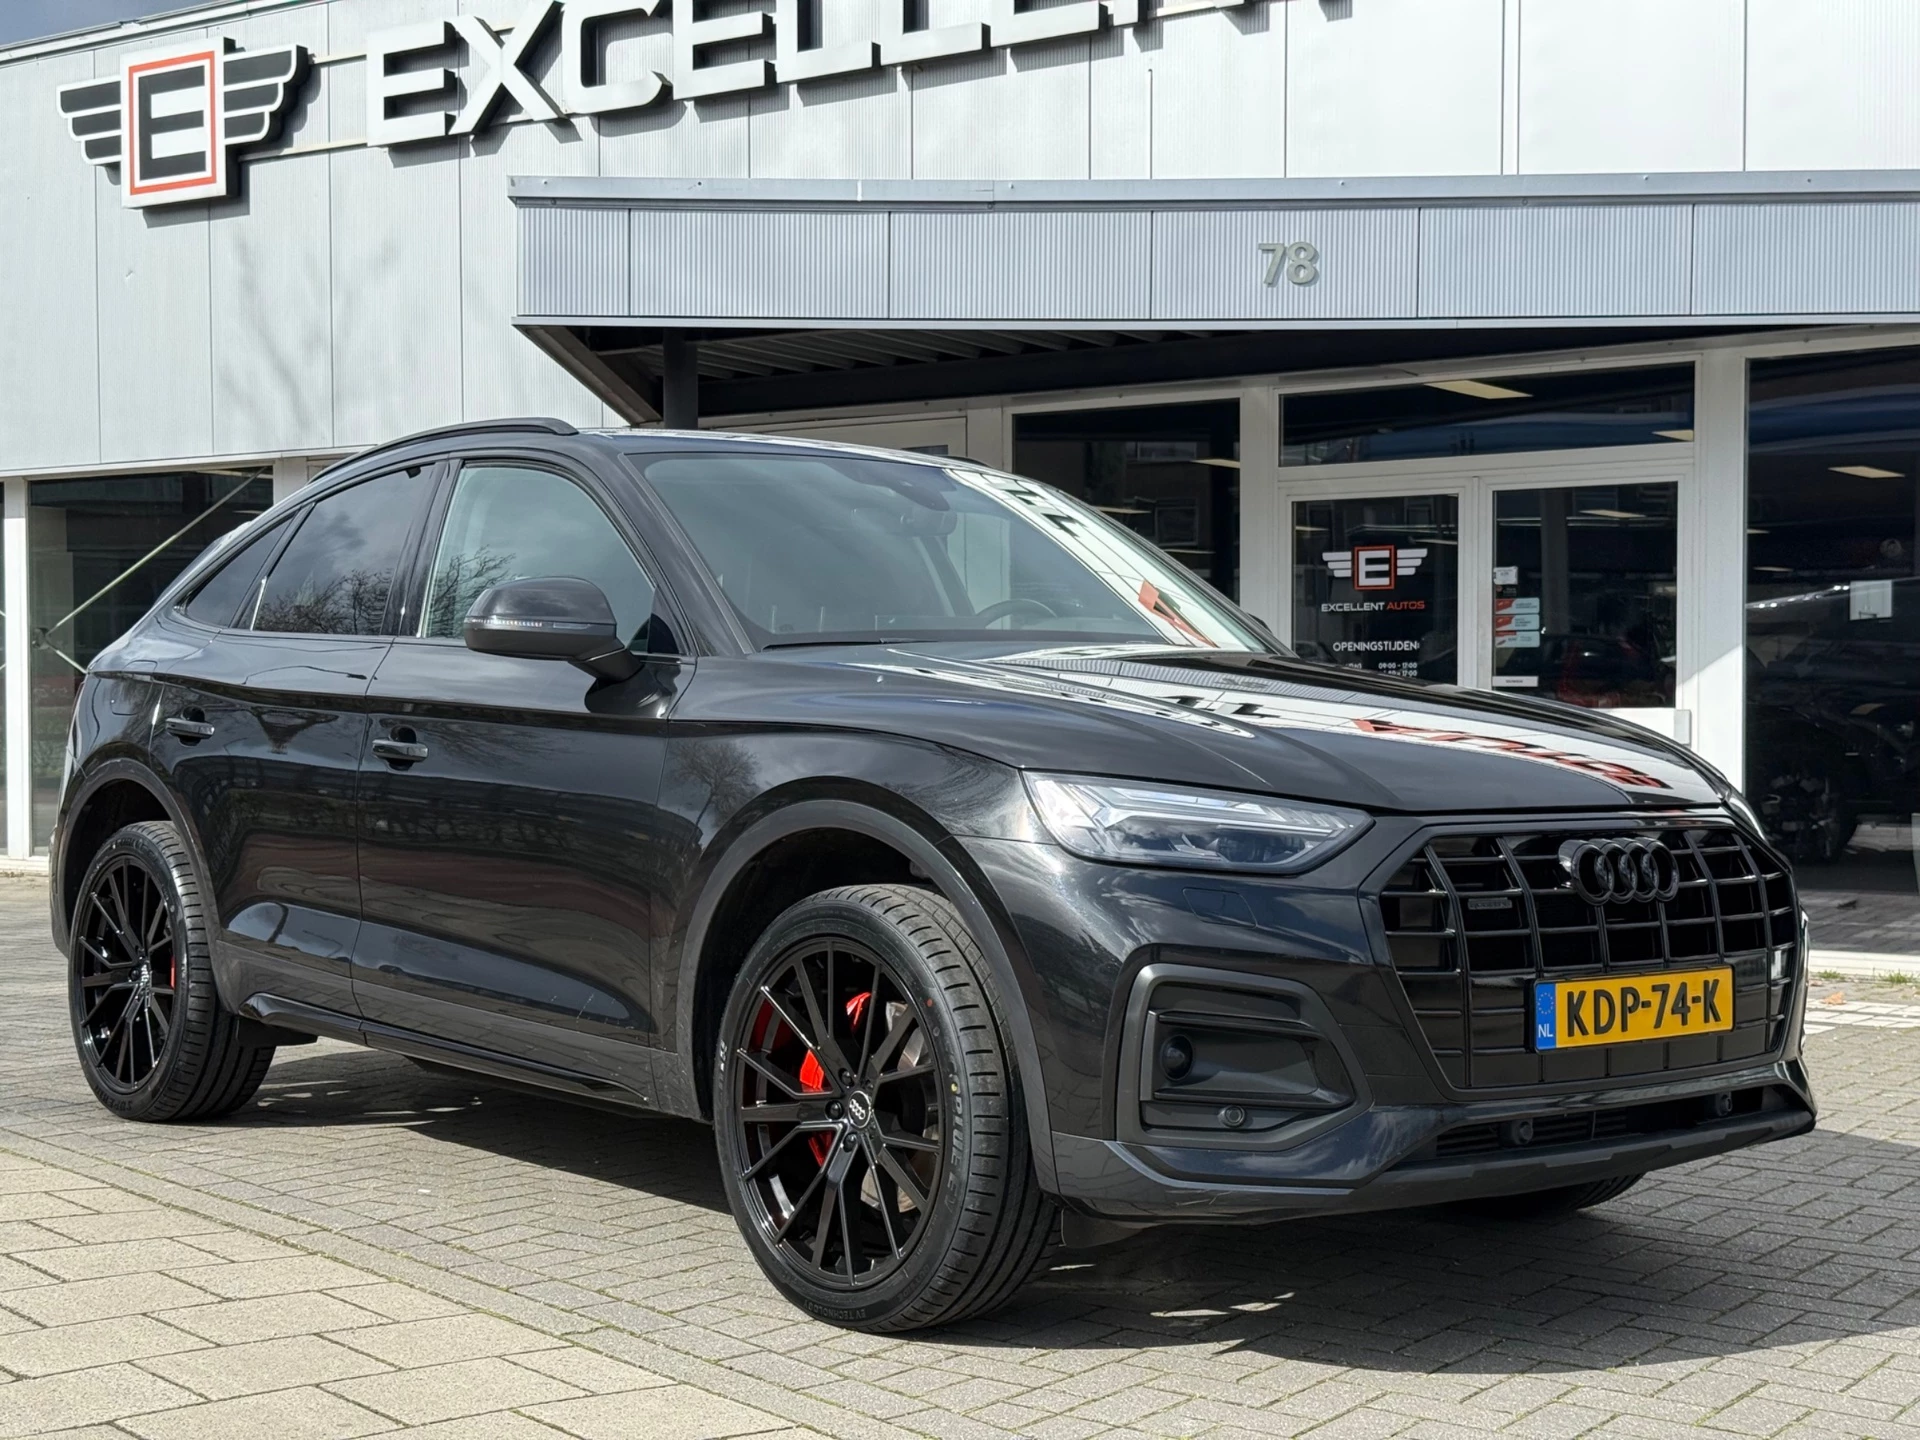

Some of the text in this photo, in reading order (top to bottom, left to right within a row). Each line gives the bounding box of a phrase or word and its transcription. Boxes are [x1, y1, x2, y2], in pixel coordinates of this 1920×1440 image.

[138, 64, 207, 181] E
[1258, 241, 1316, 285] 78
[1358, 550, 1390, 587] E
[1321, 601, 1425, 612] EXCELLENT AUTOS
[1332, 641, 1420, 652] OPENINGSTIJDEN:
[1566, 978, 1722, 1038] KDP-74-K
[1537, 1023, 1554, 1038] NL
